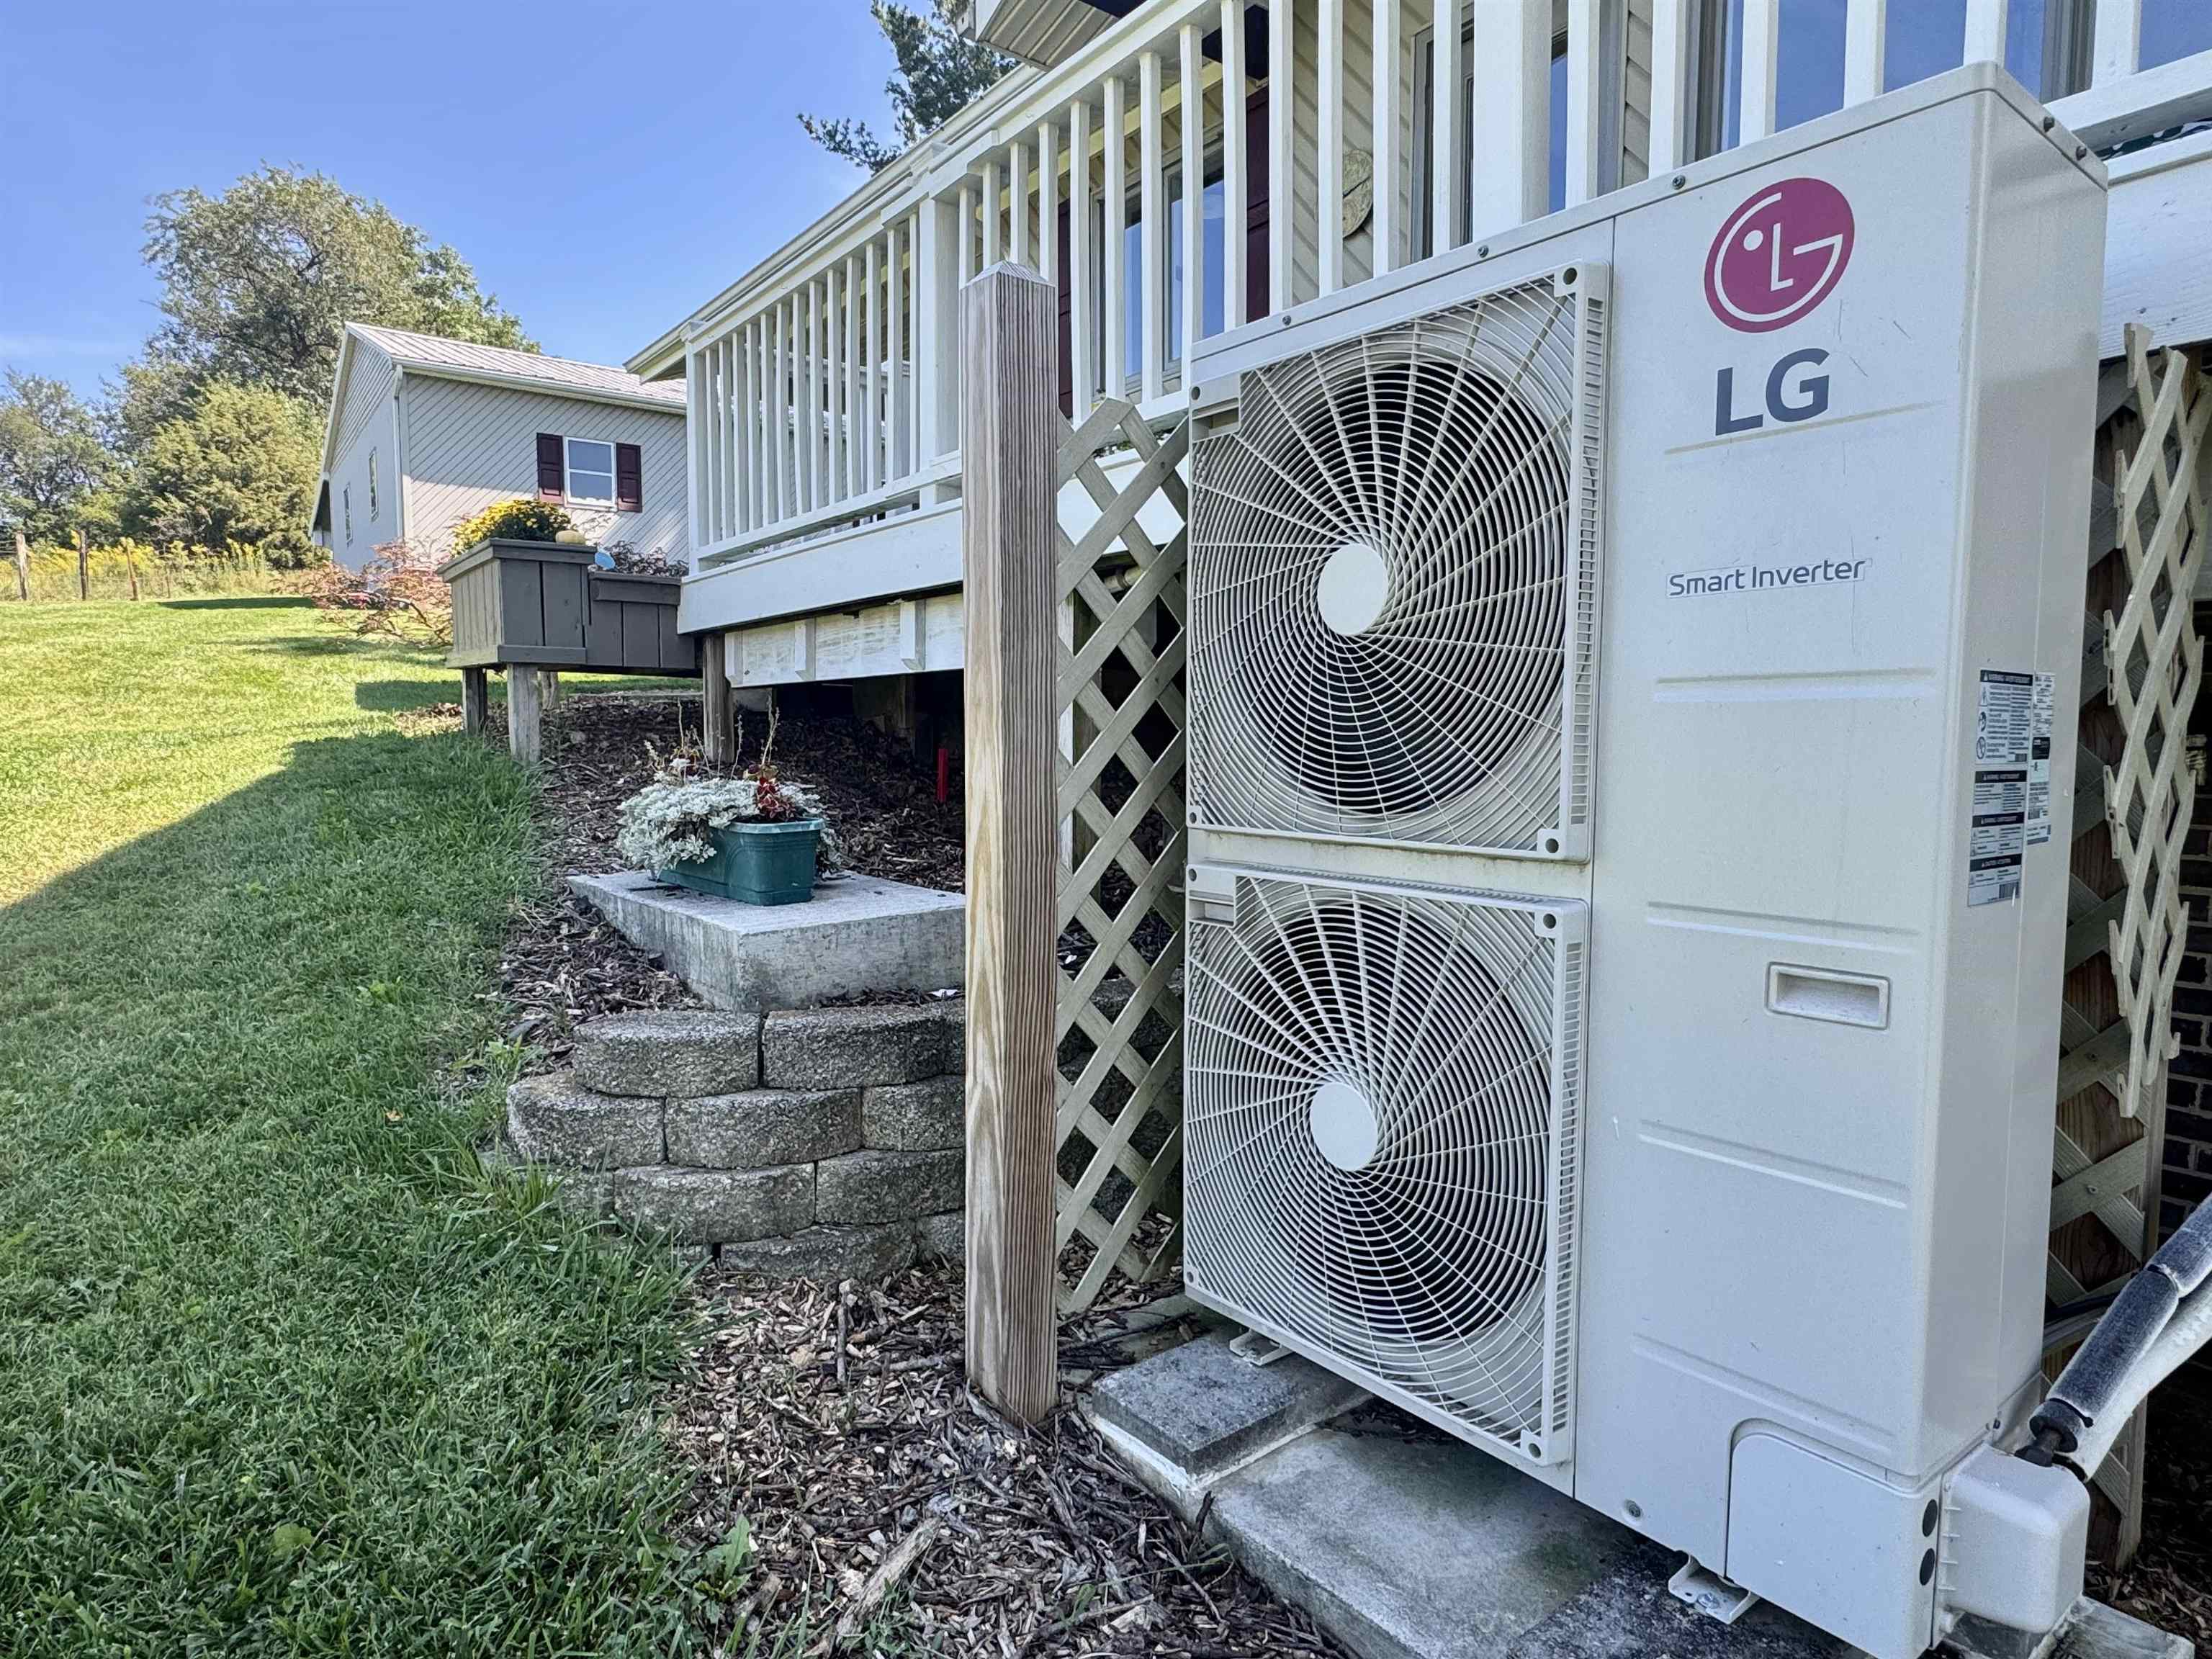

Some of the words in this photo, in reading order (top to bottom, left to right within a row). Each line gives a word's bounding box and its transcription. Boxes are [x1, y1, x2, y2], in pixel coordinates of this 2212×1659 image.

[1715, 348, 1830, 436] LG
[1668, 569, 1746, 596] Smart
[1751, 559, 1866, 589] Inverter
